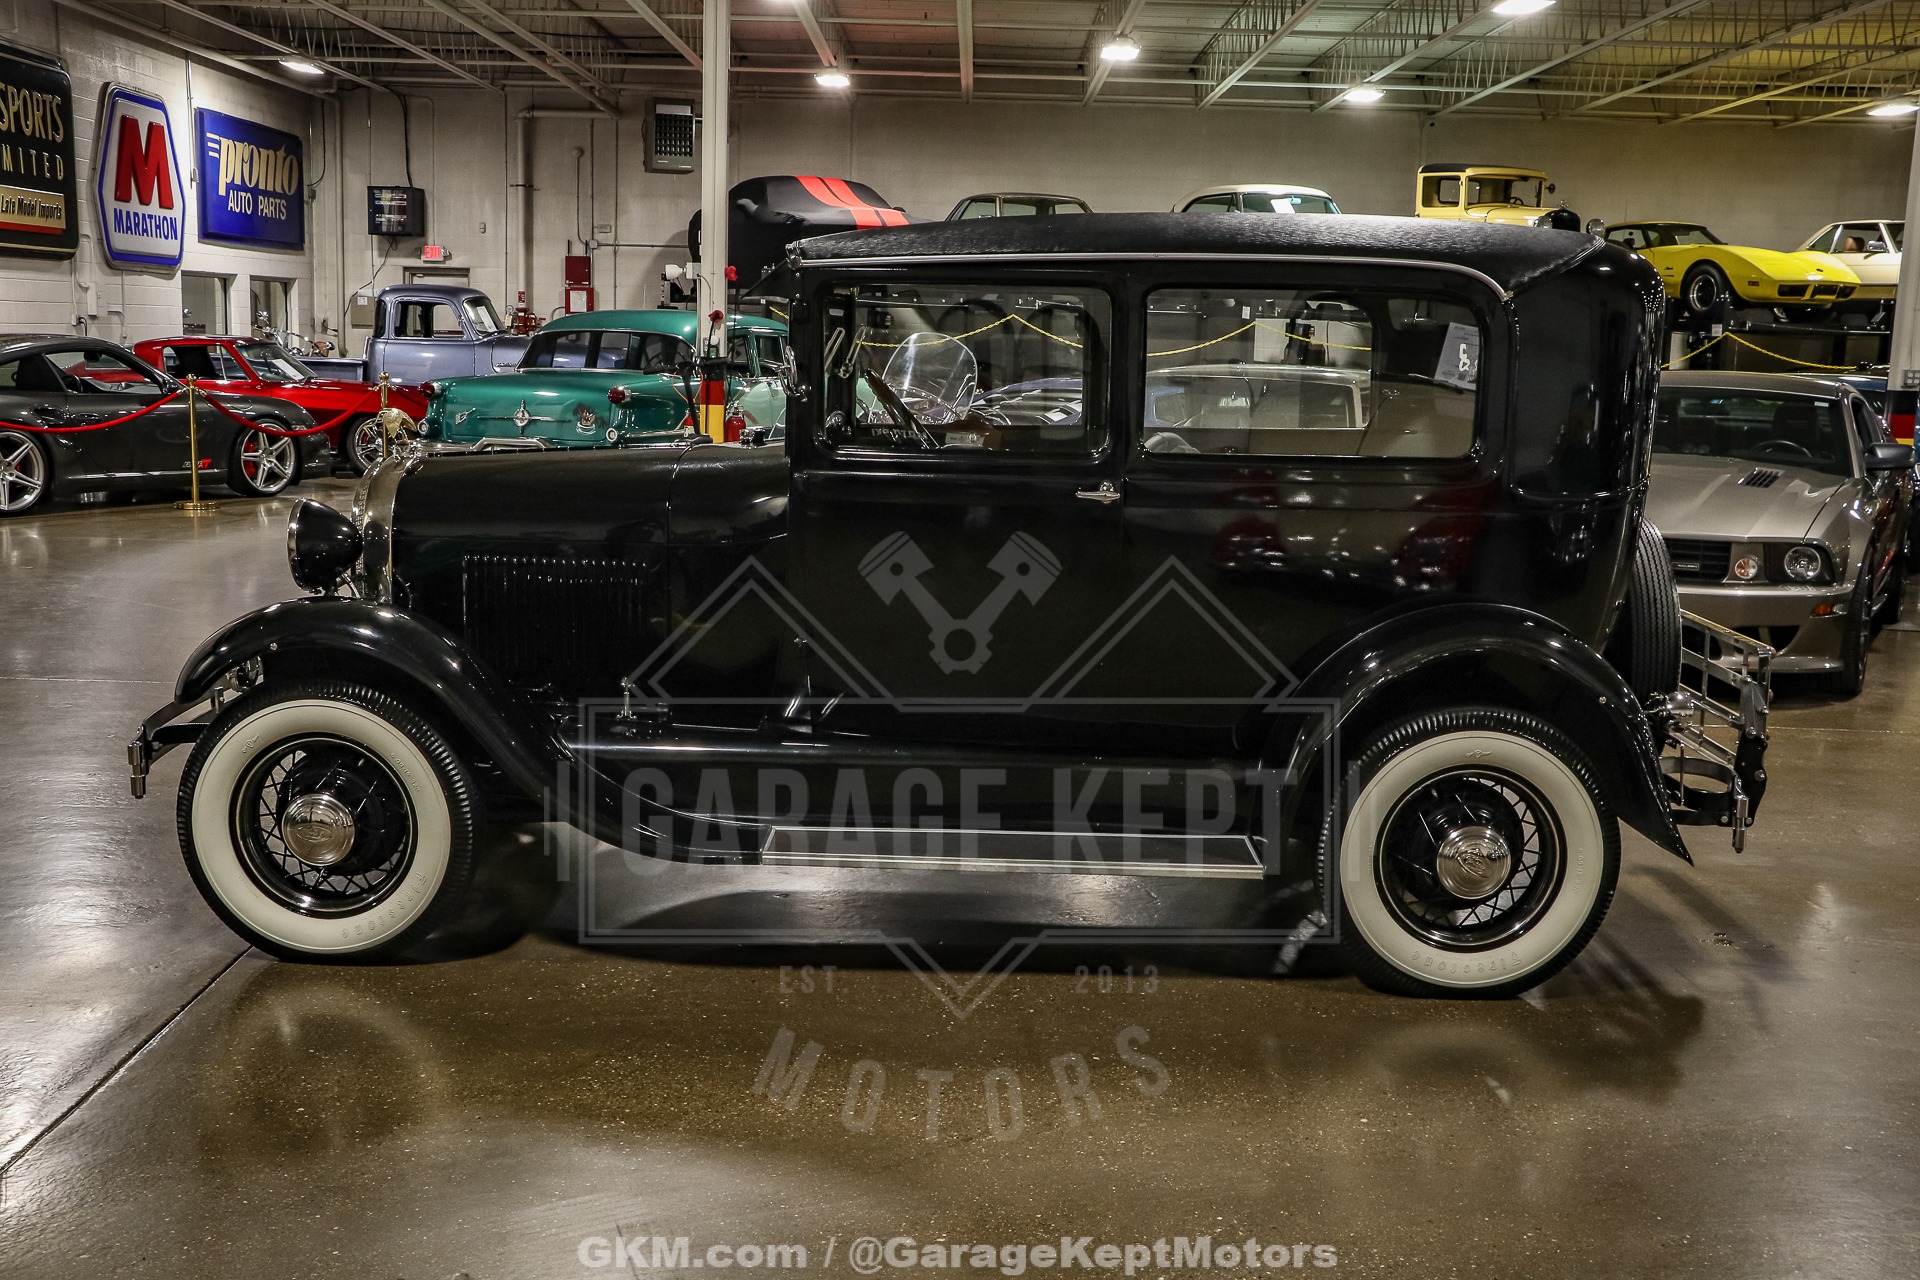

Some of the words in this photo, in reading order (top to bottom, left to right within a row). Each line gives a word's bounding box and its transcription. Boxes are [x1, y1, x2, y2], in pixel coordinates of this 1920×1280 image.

[0, 83, 64, 143] SPORTS
[114, 114, 174, 209] M
[218, 136, 299, 196] pronto
[17, 195, 37, 218] Model
[38, 198, 62, 221] Imports
[228, 189, 253, 215] AUTO
[258, 195, 287, 220] PARTS
[113, 207, 179, 240] MARATHON
[424, 246, 441, 259] EXIT
